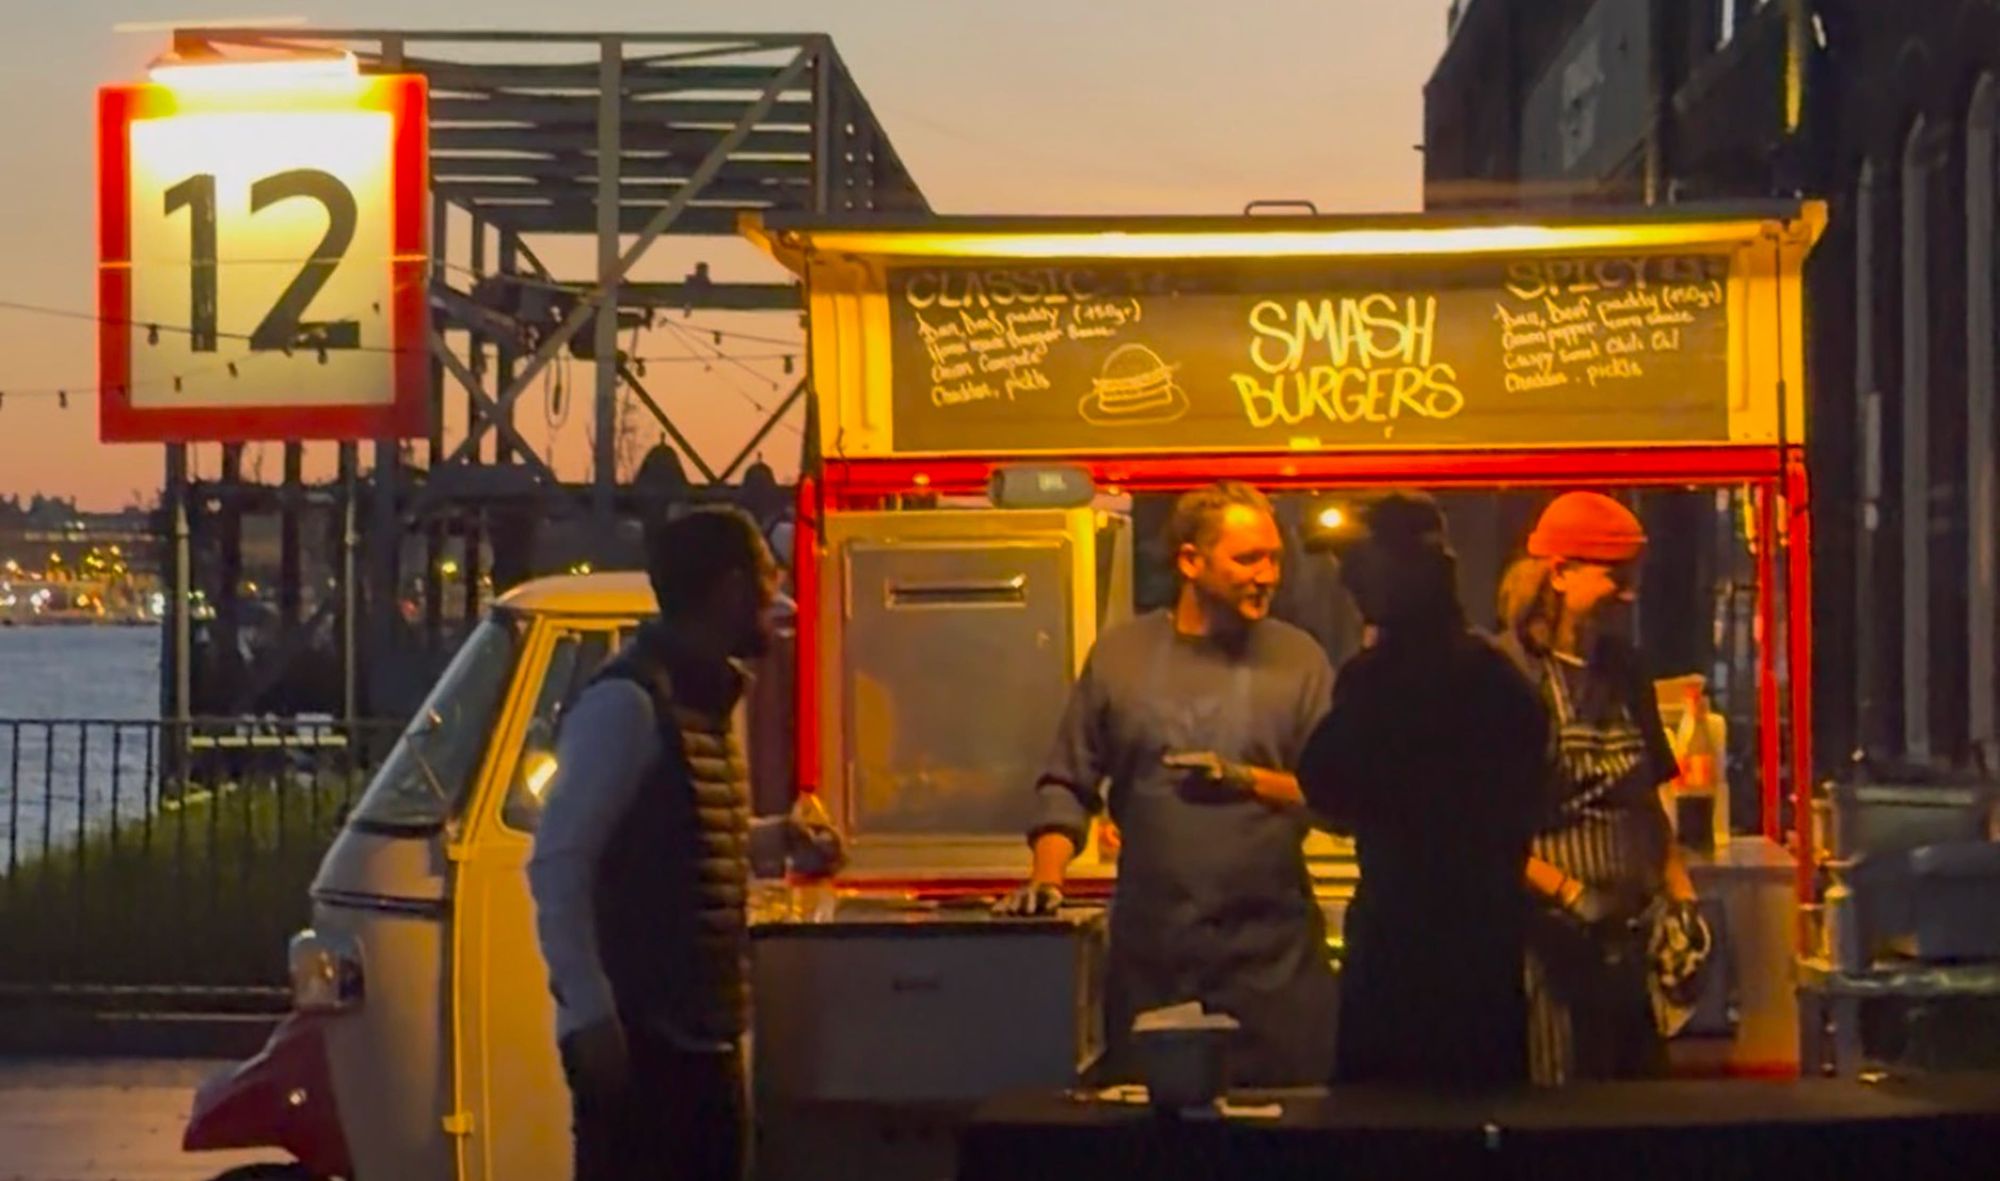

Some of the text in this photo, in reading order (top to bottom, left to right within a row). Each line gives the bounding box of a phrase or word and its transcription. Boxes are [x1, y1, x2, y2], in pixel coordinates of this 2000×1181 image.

[164, 168, 360, 353] 12
[906, 269, 1098, 308] CLASSIC
[1249, 293, 1436, 374] SMASH
[1229, 363, 1464, 428] BURGERS
